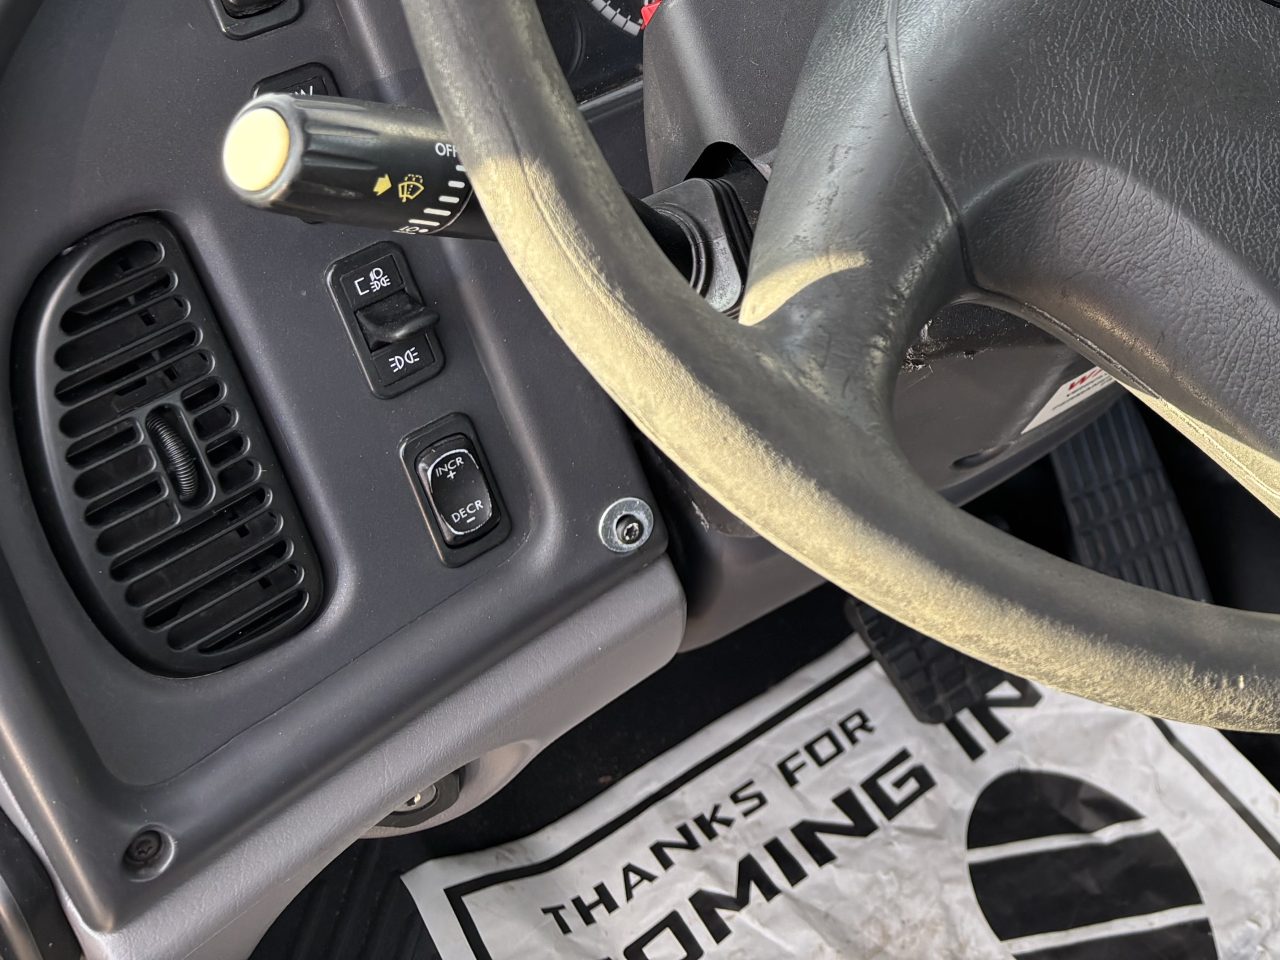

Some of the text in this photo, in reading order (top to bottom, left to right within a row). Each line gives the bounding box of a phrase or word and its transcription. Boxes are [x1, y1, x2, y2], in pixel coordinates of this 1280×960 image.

[435, 456, 465, 477] INCR
[451, 499, 484, 523] DECR
[540, 708, 876, 936] THANKS FOR
[600, 747, 937, 960] OMING
